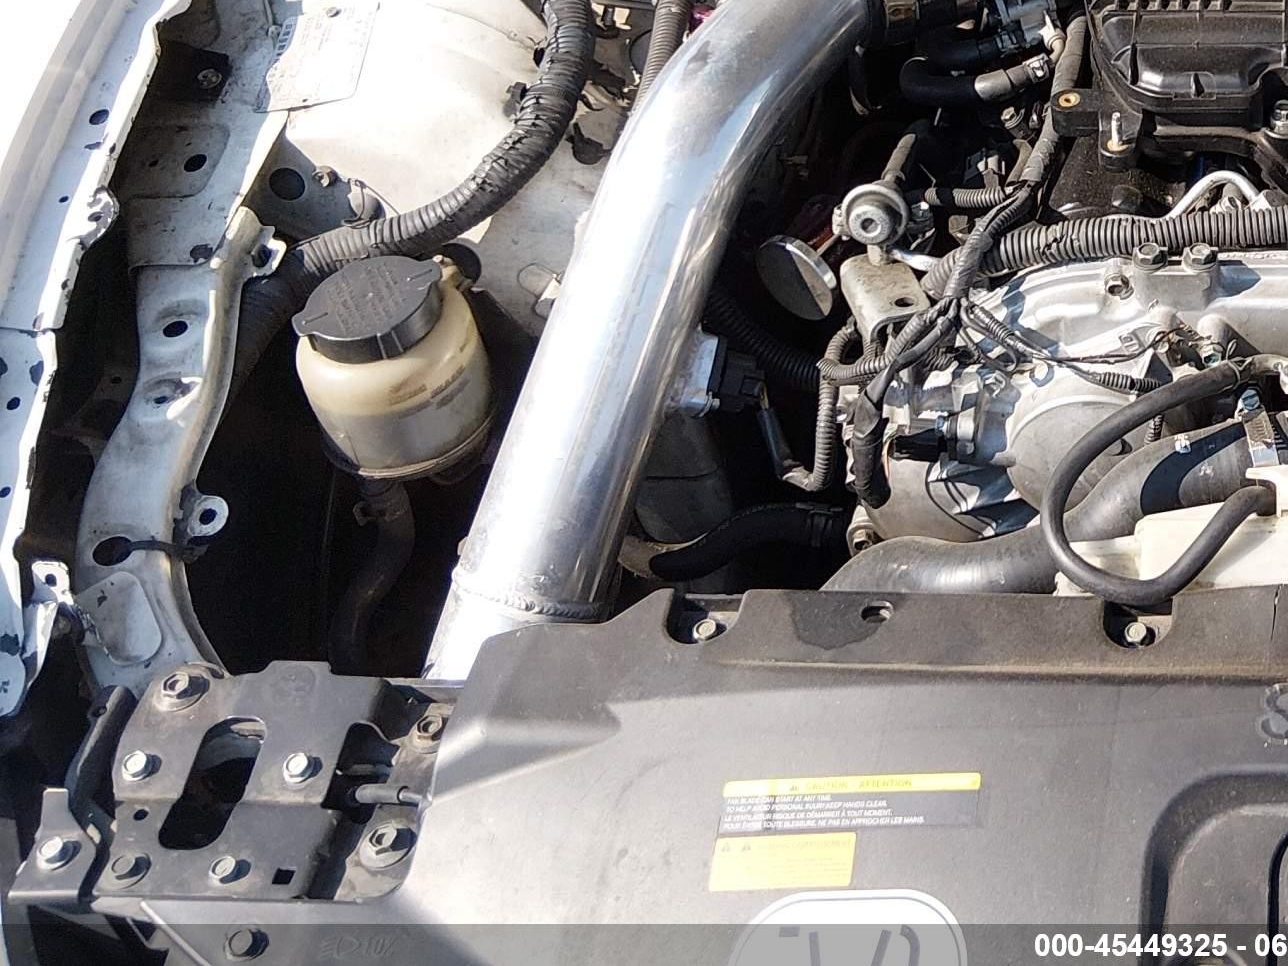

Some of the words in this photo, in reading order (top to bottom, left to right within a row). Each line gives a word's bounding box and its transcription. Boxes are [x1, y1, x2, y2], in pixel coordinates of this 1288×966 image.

[806, 780, 848, 791] CAUTION
[859, 777, 913, 788] ATTENTION
[843, 800, 864, 808] HANDS
[847, 809, 864, 817] TOUT
